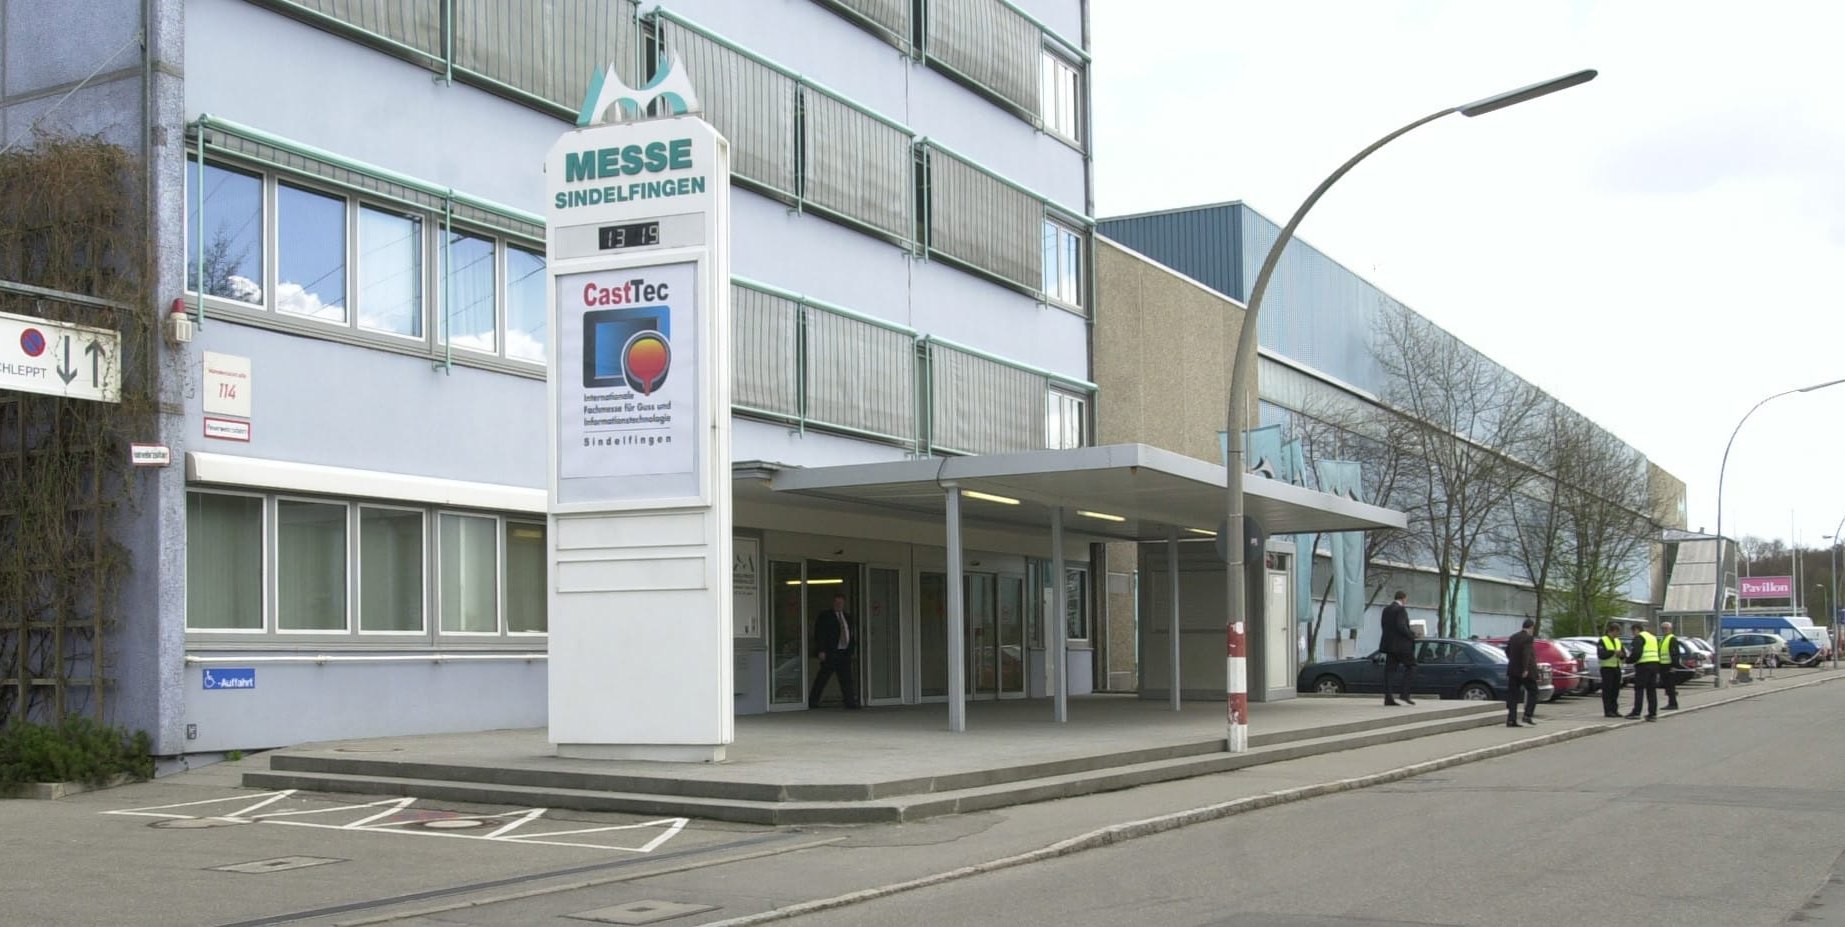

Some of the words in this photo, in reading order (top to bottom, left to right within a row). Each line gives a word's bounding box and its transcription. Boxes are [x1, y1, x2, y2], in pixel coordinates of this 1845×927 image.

[565, 138, 693, 183] MESSE
[555, 176, 706, 209] SINDELFINGEN
[608, 228, 626, 248] 13
[641, 224, 659, 244] 19
[583, 278, 669, 306] CastTec
[0, 362, 47, 379] HLEPPT
[219, 382, 236, 400] 114
[583, 391, 634, 402] Internationale
[583, 405, 622, 414] Fachmesse
[624, 403, 635, 412] für
[637, 402, 655, 411] Guss
[657, 400, 671, 410] und
[583, 414, 671, 426] Informationstechnologie
[583, 435, 671, 447] Sindelfingen
[1742, 582, 1788, 593] Pavillon
